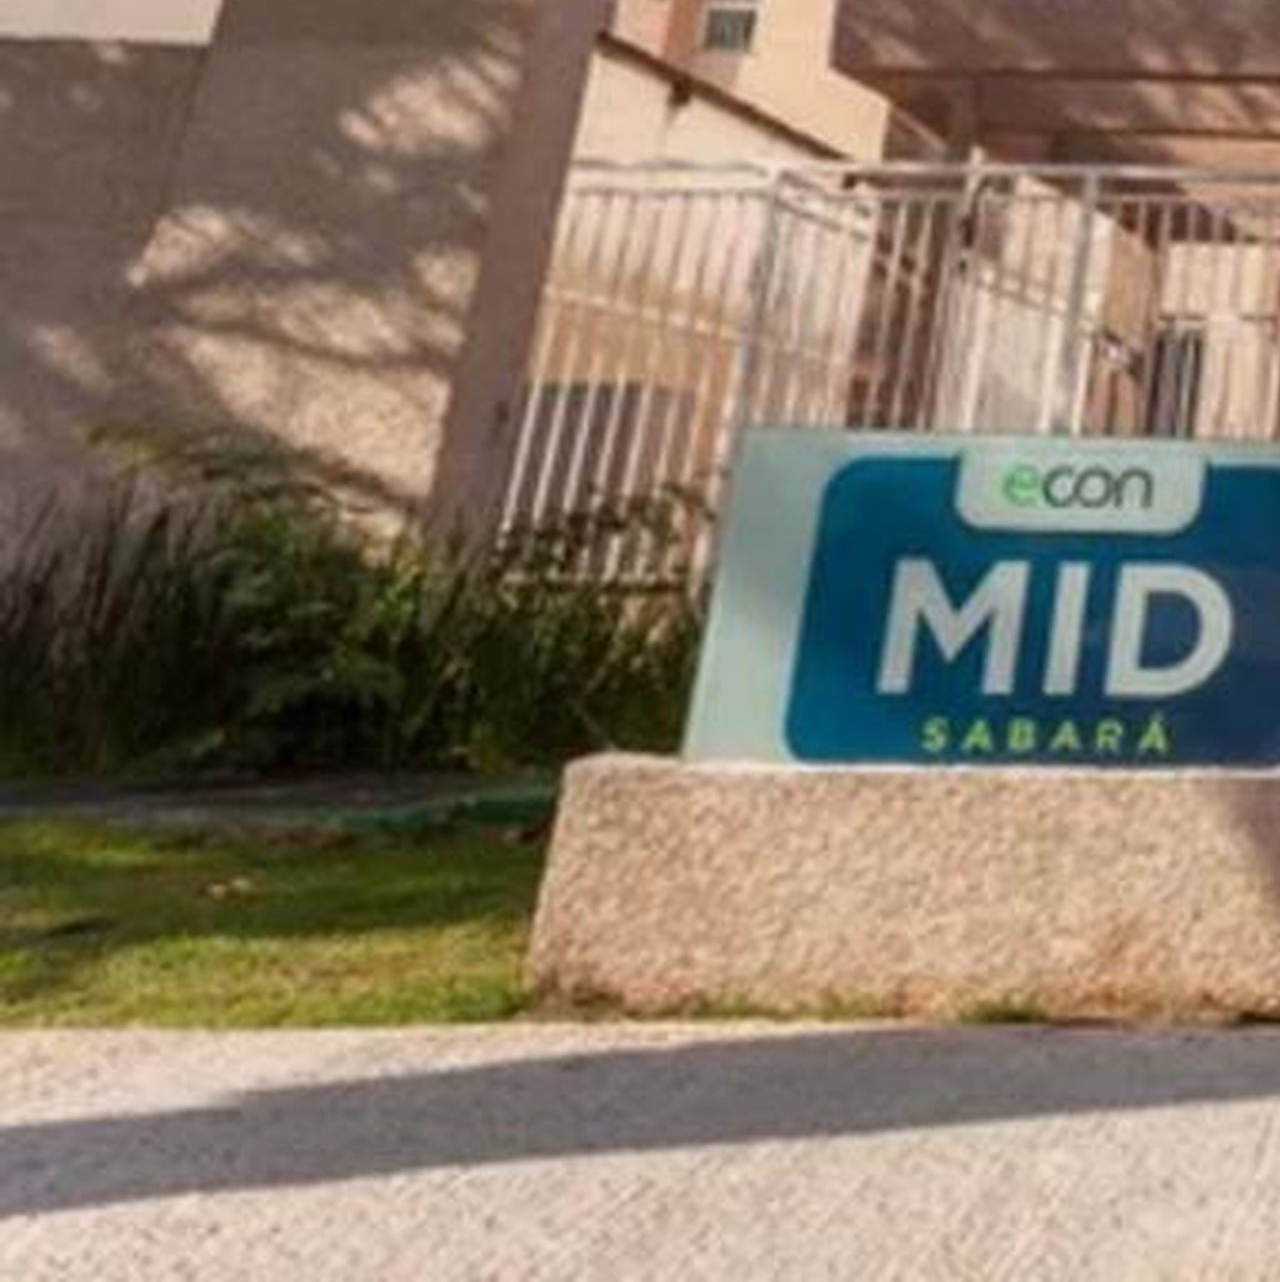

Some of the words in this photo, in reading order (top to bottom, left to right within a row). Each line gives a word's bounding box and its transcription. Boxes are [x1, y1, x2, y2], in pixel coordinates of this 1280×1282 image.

[1004, 463, 1154, 509] econ
[877, 557, 1233, 697] MID
[921, 713, 1171, 754] SABARÁ
